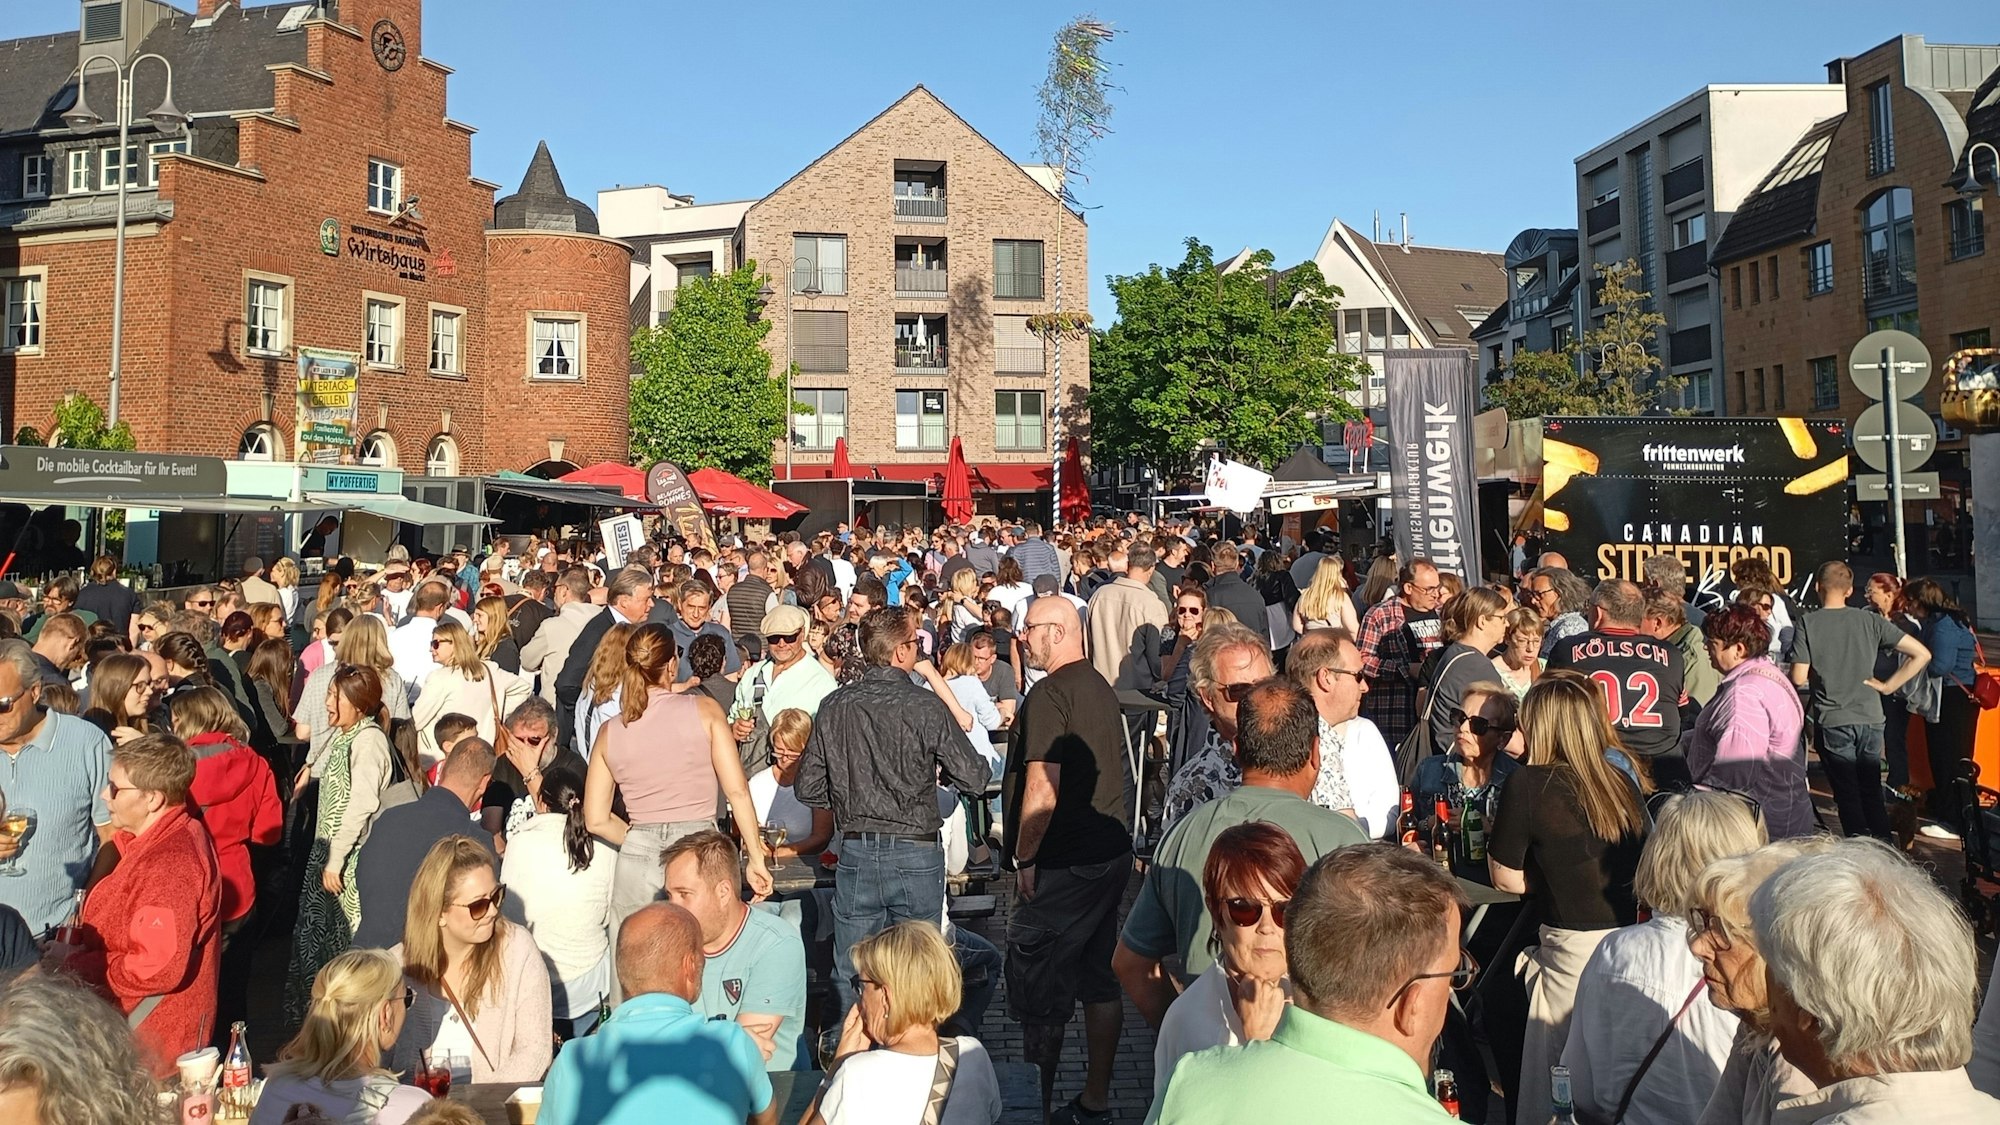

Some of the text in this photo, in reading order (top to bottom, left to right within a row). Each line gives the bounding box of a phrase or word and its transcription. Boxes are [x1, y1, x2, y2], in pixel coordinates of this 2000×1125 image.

[347, 237, 426, 271] Wirtshaus
[304, 380, 353, 391] VATERTAGS-
[312, 395, 345, 406] GRILLEN
[314, 423, 344, 434] Familienfest
[1642, 443, 1746, 463] frittenwerk
[37, 456, 197, 477] Die mobile Cocktailbar für Ihr Event!
[328, 474, 376, 489] MY POFFERTJES
[658, 490, 691, 506] POMMES
[1623, 523, 1763, 544] CANADIAN
[617, 524, 630, 567] ERTJES
[1572, 638, 1669, 667] KÖLSCH
[1589, 670, 1663, 728] 0,2
